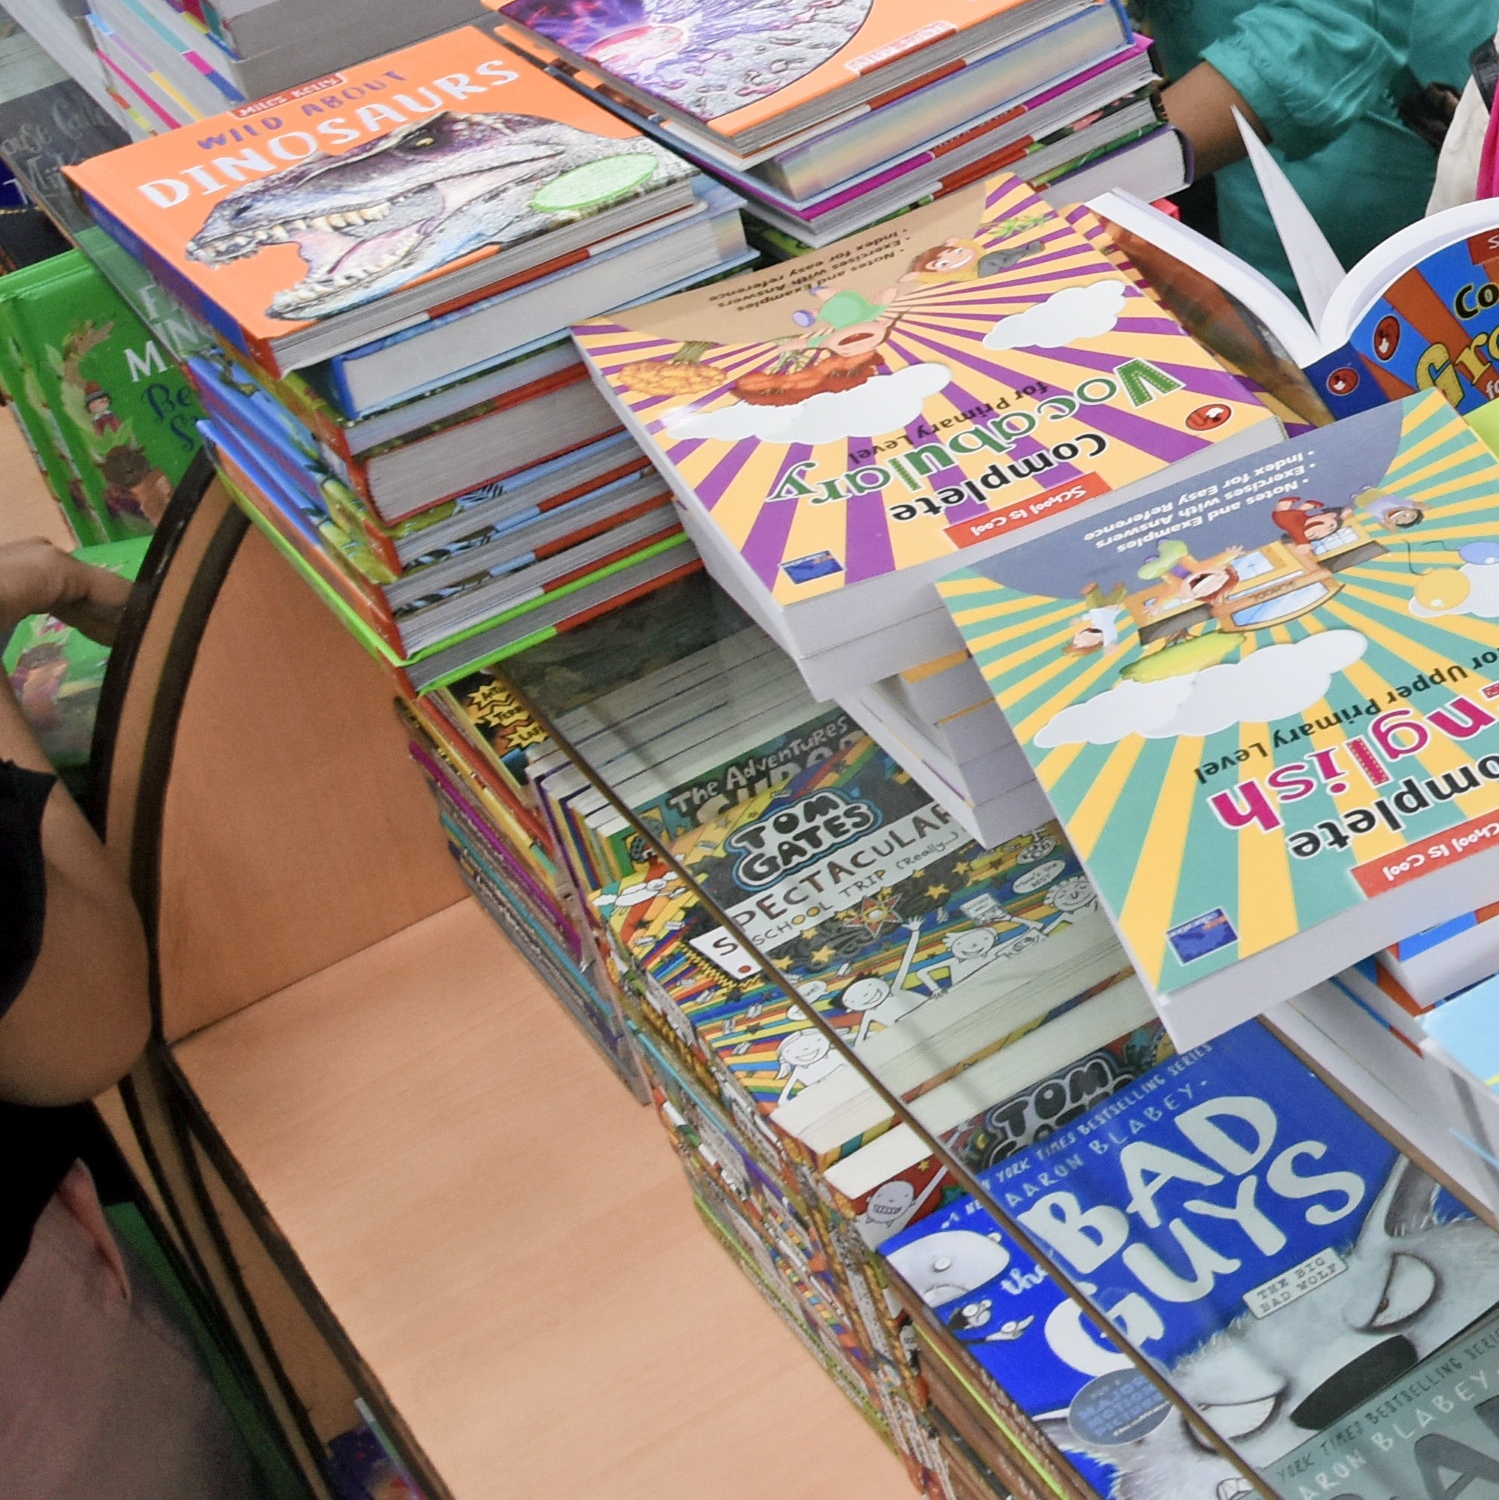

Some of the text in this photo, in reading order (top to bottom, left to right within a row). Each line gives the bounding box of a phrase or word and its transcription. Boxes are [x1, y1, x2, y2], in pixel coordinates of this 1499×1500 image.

[136, 59, 521, 209] DINOSAURS
[197, 70, 408, 150] WILD ABOUT
[709, 231, 898, 301] Index for easy reference
[717, 240, 901, 308] Exercises with Answers
[737, 252, 895, 312] Notes and Examples
[766, 358, 1188, 507] Vocabulary
[847, 380, 1049, 465] for Primary Level
[887, 433, 1108, 522] Complete
[1027, 484, 1087, 513] School
[1083, 452, 1303, 541] Index for Easy Reference
[1095, 464, 1305, 549] Exercises with Answers
[1116, 480, 1298, 553] Notes and Examples
[969, 513, 1008, 536] Cool
[1271, 697, 1383, 750] Primary
[1385, 664, 1469, 705] Upper
[668, 778, 720, 814] The
[726, 715, 848, 792] Adventures
[1193, 742, 1270, 785] Level
[735, 794, 841, 850] TOM
[741, 802, 875, 882] GATES
[1381, 852, 1426, 883] Cool
[751, 901, 834, 950] SCHOOL
[838, 868, 887, 902] TRIP
[994, 1061, 1110, 1138] TOM
[995, 1043, 1213, 1184] YORK TIMES BESTSELLING SERIES
[1003, 1154, 1085, 1209] AARON
[1089, 1081, 1195, 1156] BLABEY
[1016, 1095, 1278, 1275] BAD
[1001, 1263, 1051, 1296] the
[1044, 1139, 1366, 1377] GUYS
[1257, 1256, 1327, 1301] THE BIG
[1258, 1263, 1339, 1314] BAD WOLF
[1277, 1454, 1313, 1485] YORK
[1320, 1420, 1363, 1457] TIMES
[1365, 1357, 1464, 1426] BESTSELLING
[1299, 1368, 1491, 1500] ARON BLABEY
